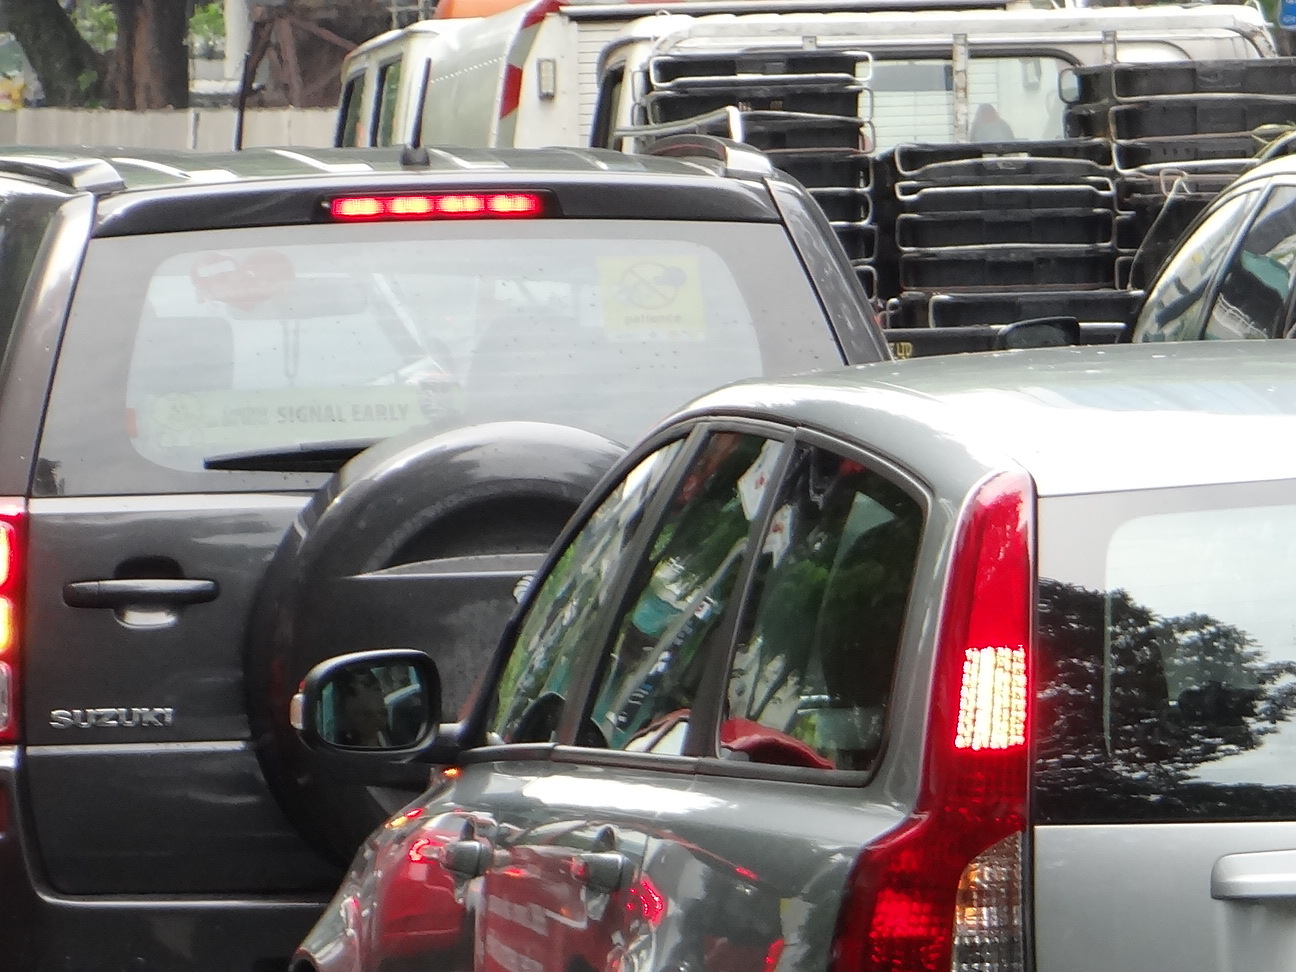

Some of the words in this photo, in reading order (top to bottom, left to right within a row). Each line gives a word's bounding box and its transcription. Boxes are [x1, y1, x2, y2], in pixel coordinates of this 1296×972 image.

[277, 405, 346, 424] SIGNAL
[349, 403, 410, 422] EARLY
[50, 707, 174, 730] SUZUKI
